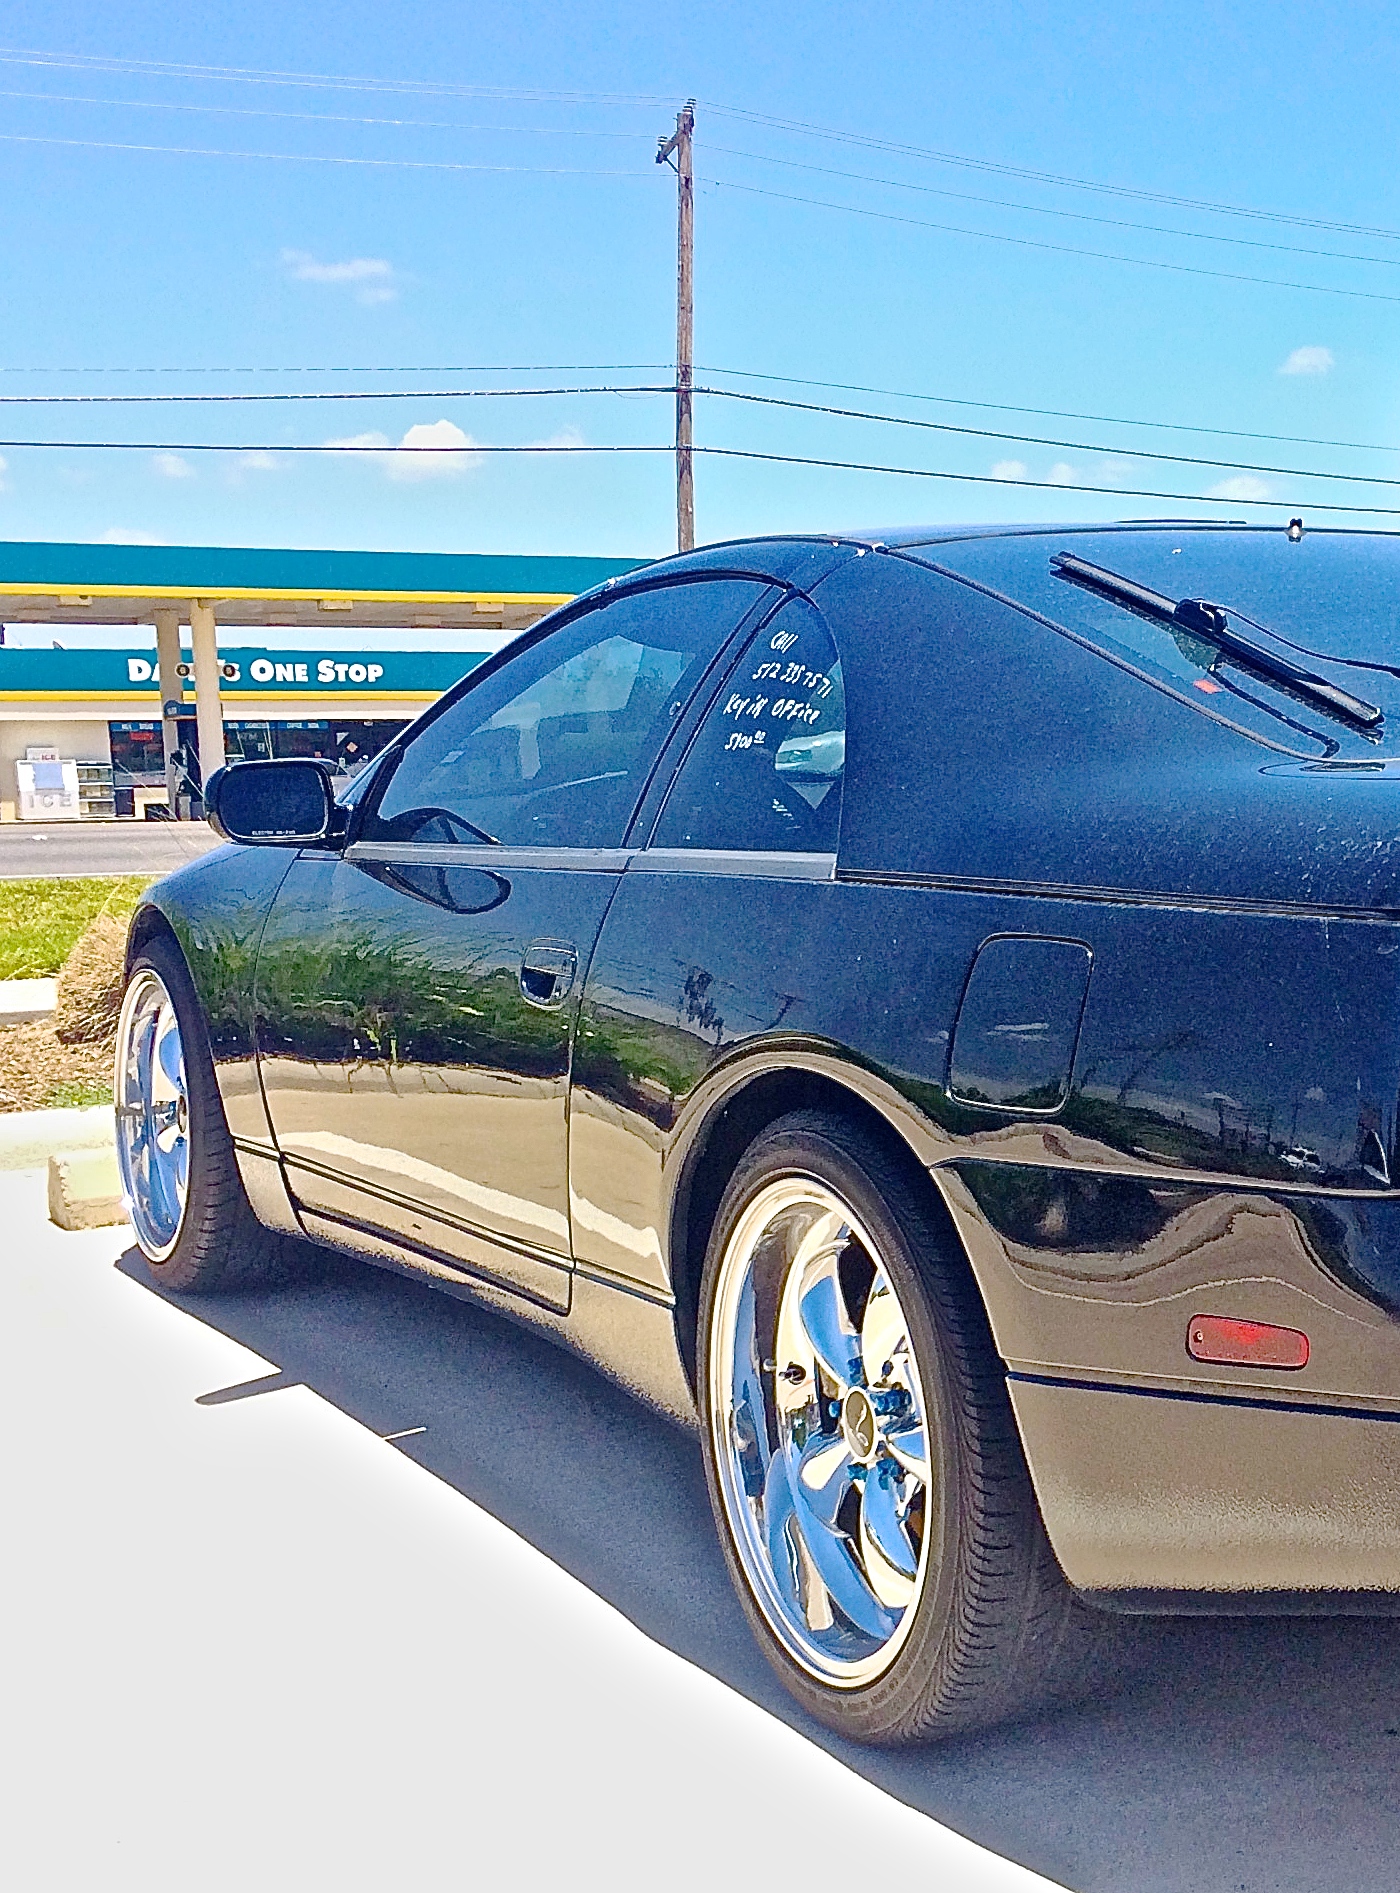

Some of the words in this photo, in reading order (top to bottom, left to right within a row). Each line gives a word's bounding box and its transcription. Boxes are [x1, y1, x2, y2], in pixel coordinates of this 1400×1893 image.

[250, 658, 308, 682] ONE
[317, 659, 383, 682] STOP
[752, 662, 781, 680] 512
[28, 793, 72, 808] ICE
